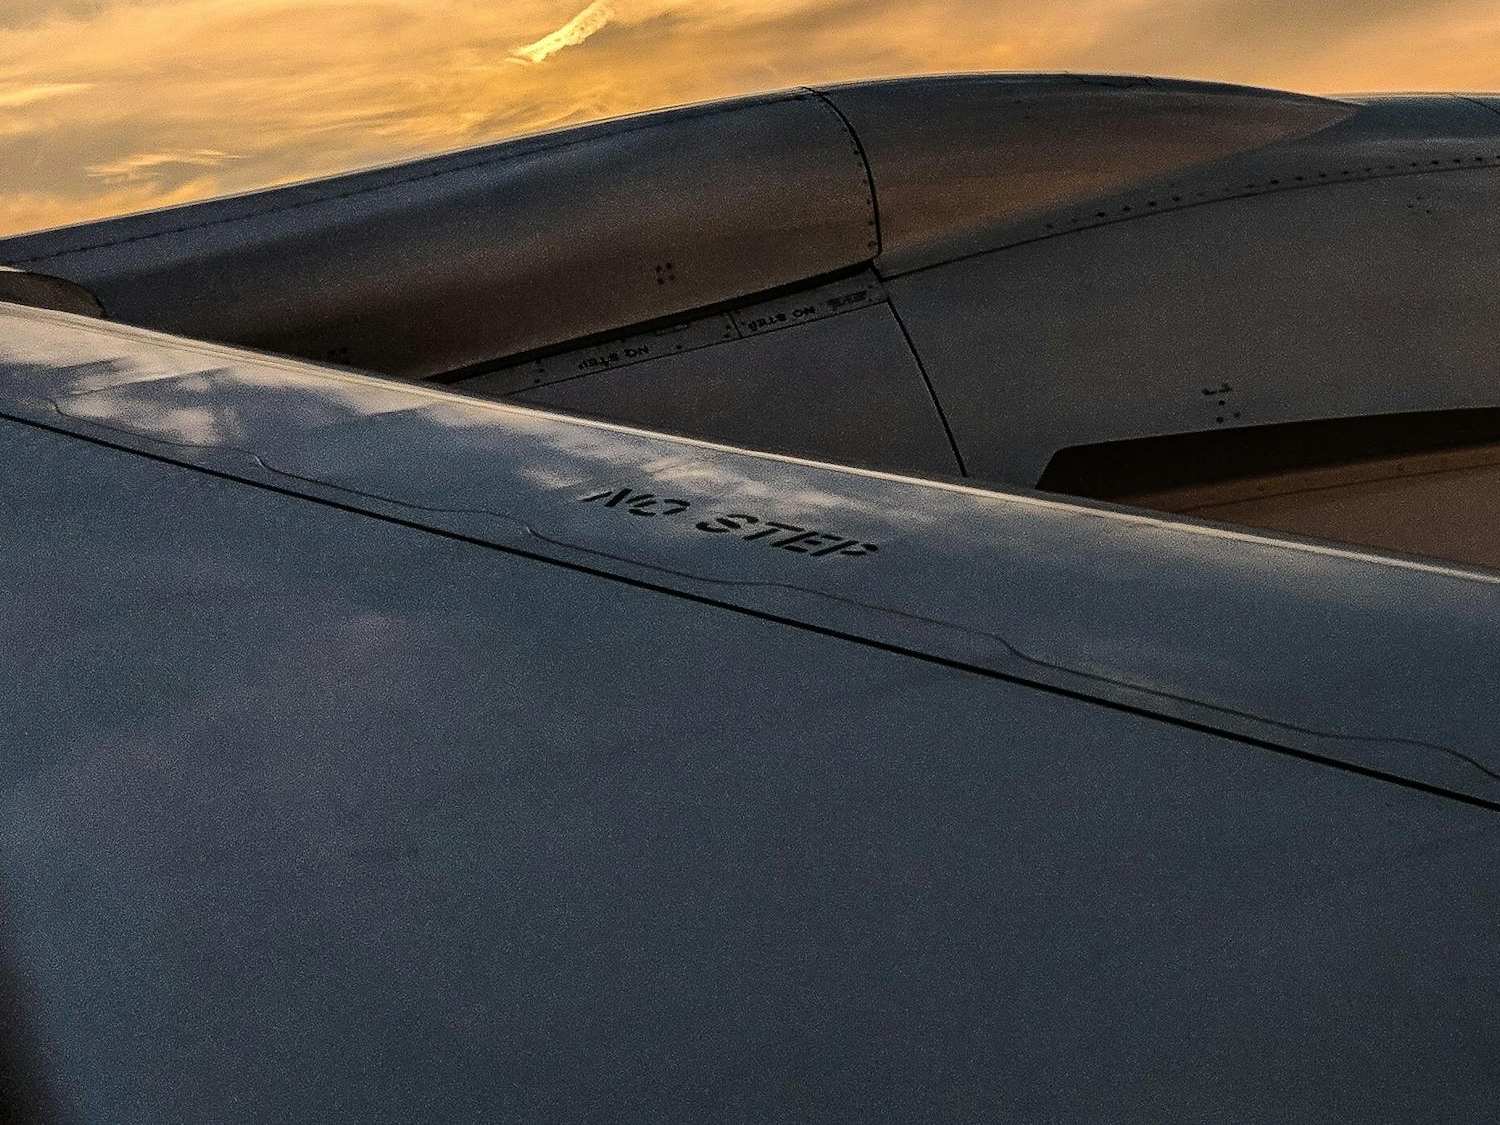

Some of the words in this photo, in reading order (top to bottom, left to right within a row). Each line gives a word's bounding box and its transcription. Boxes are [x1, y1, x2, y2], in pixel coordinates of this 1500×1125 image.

[791, 305, 816, 318] NO
[747, 312, 787, 332] STEP
[623, 345, 649, 358] NO
[577, 353, 619, 370] STEP
[582, 488, 691, 517] NO
[695, 513, 878, 557] STEP
